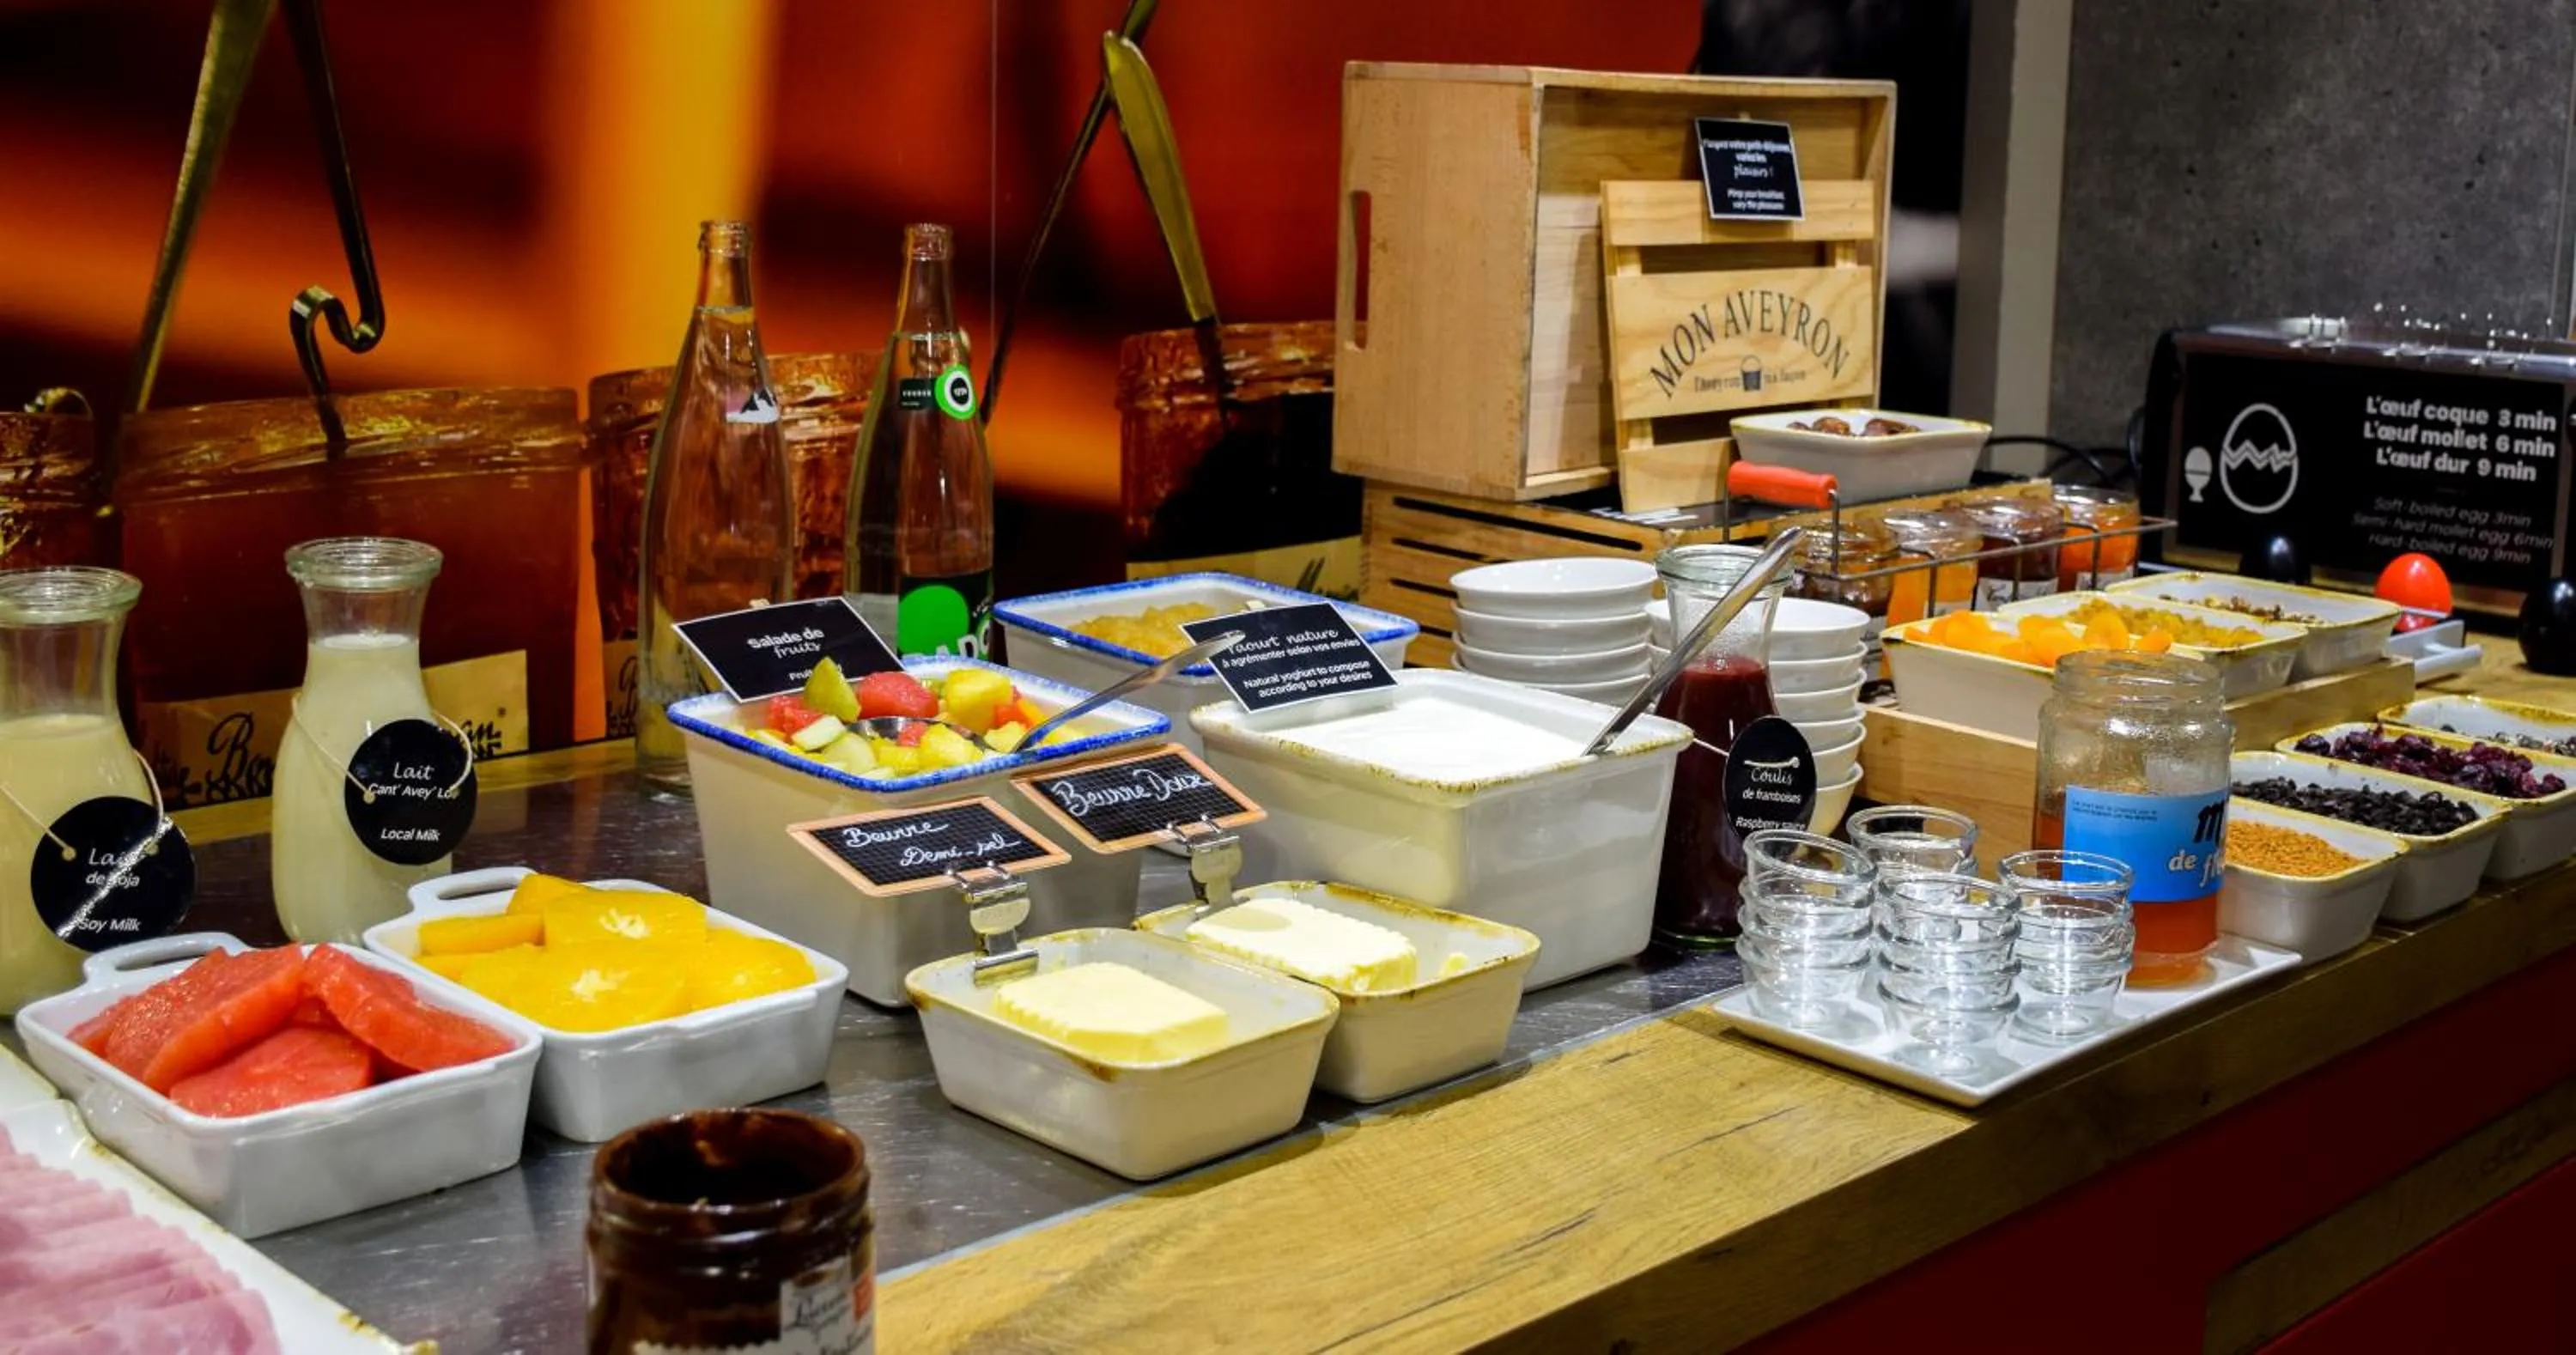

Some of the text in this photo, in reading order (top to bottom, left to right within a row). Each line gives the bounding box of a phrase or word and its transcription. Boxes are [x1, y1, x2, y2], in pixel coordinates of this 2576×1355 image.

[1649, 289, 1850, 399] MON AVEYRON
[2423, 404, 2489, 428] coque
[2498, 408, 2512, 428] 3
[2514, 410, 2557, 432] min
[2421, 428, 2488, 452] mollet
[2494, 434, 2511, 453] 6
[2513, 435, 2556, 459] min
[2433, 452, 2470, 474] dur
[2476, 458, 2492, 477] 9
[2494, 459, 2537, 483] min
[2458, 508, 2489, 526] egg
[2477, 528, 2510, 546] egg
[2458, 544, 2489, 562] egg
[746, 626, 825, 649] Salade de
[1285, 628, 1340, 645] nature
[773, 641, 822, 659] fruits
[1286, 644, 1314, 658] selon
[1314, 642, 1331, 653] vos
[1330, 637, 1361, 651] envies
[1243, 659, 1371, 690] Natural yoghurt to compose
[1258, 670, 1374, 699] according to your desires
[392, 761, 435, 781] Lait
[1750, 767, 1793, 786] Coulis
[1050, 768, 1215, 817] Beurre Doux
[1741, 787, 1801, 805] de framboises
[1735, 816, 1780, 830] Raspberry
[380, 827, 440, 842] Local Milk
[841, 820, 950, 848] Beurre
[2168, 848, 2198, 872] de
[85, 870, 105, 884] de
[78, 917, 142, 934] Soy Milk
